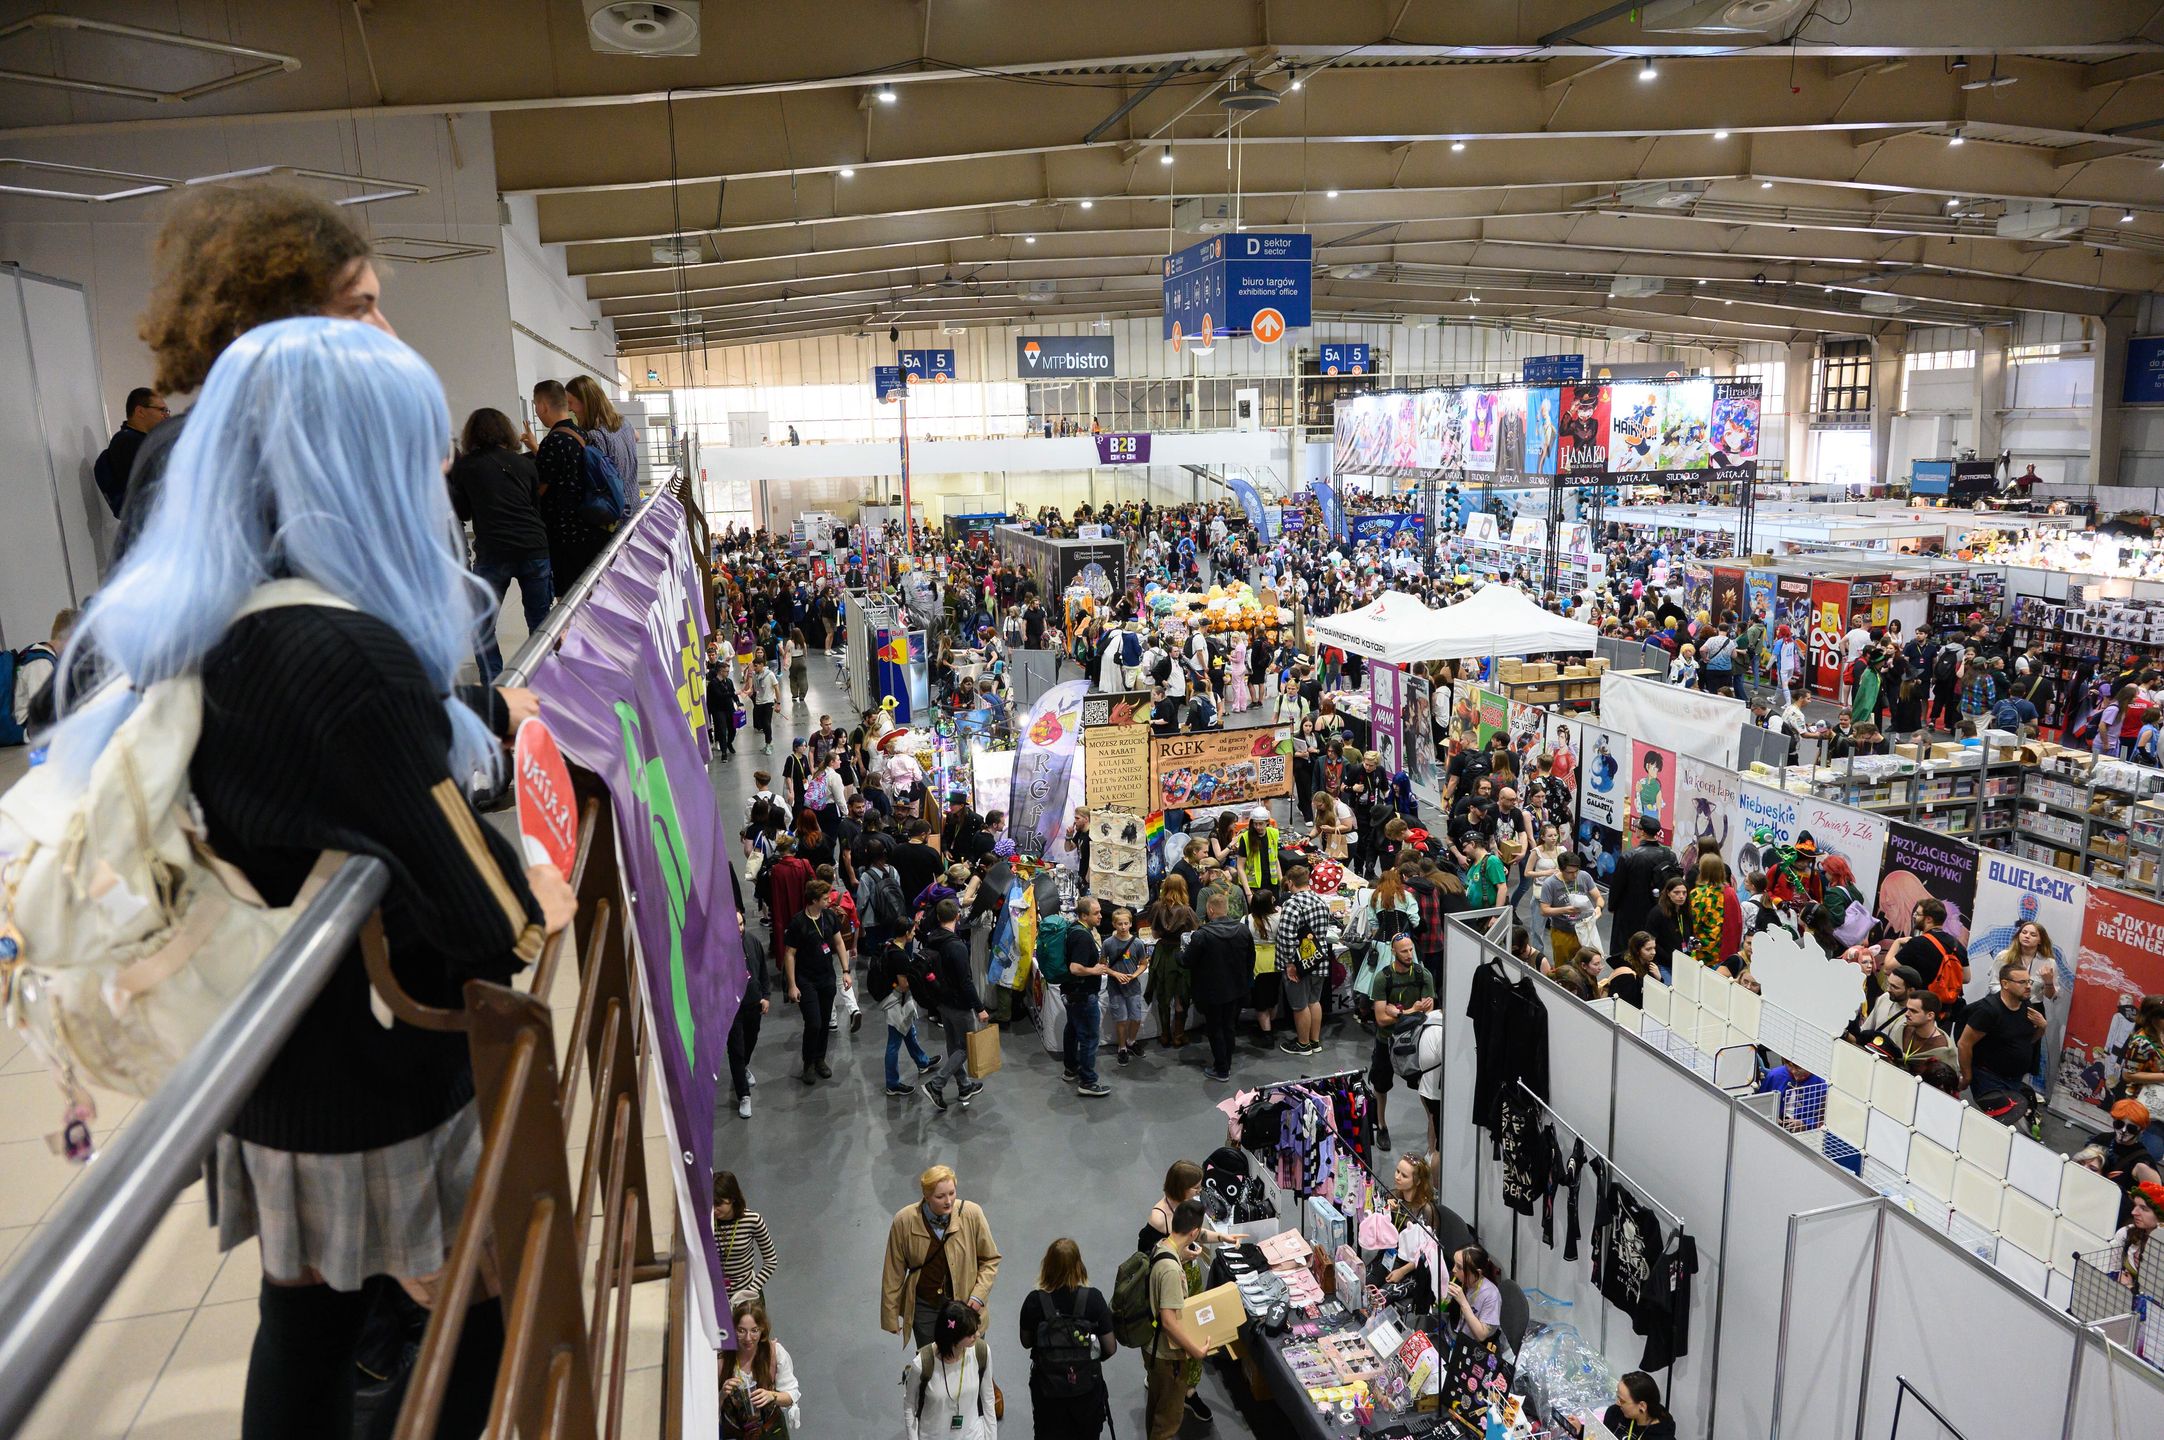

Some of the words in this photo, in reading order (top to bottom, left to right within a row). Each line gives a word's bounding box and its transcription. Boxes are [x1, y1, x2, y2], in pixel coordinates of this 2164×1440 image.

[1247, 238, 1260, 255] D
[1263, 238, 1292, 247] sektor
[1242, 277, 1264, 286] biuro
[1266, 277, 1295, 288] targów
[1279, 288, 1298, 296] office
[904, 354, 921, 368] 5A
[936, 353, 946, 368] 5
[1042, 353, 1109, 370] MTPbistro
[1324, 348, 1340, 361] 5A
[1353, 348, 1361, 361] 5
[1110, 437, 1136, 452] B2B
[1560, 444, 1606, 470] HANAKO
[1316, 625, 1361, 645] WYDAWNICTWO
[1361, 638, 1386, 653] KOTORI
[1374, 708, 1394, 728] NANA
[1120, 737, 1145, 746] RZUCIĆ
[1228, 736, 1247, 745] graczy
[1160, 741, 1205, 756] RGFK
[1227, 744, 1248, 753] graczy!
[1098, 766, 1142, 776] DOSTANIESZ
[1684, 770, 1694, 785] Na
[1586, 798, 1613, 813] GALARETA
[1740, 794, 1795, 825] Niebieskie
[1811, 810, 1851, 838] Kwiaty
[1301, 949, 1323, 970] RPG
